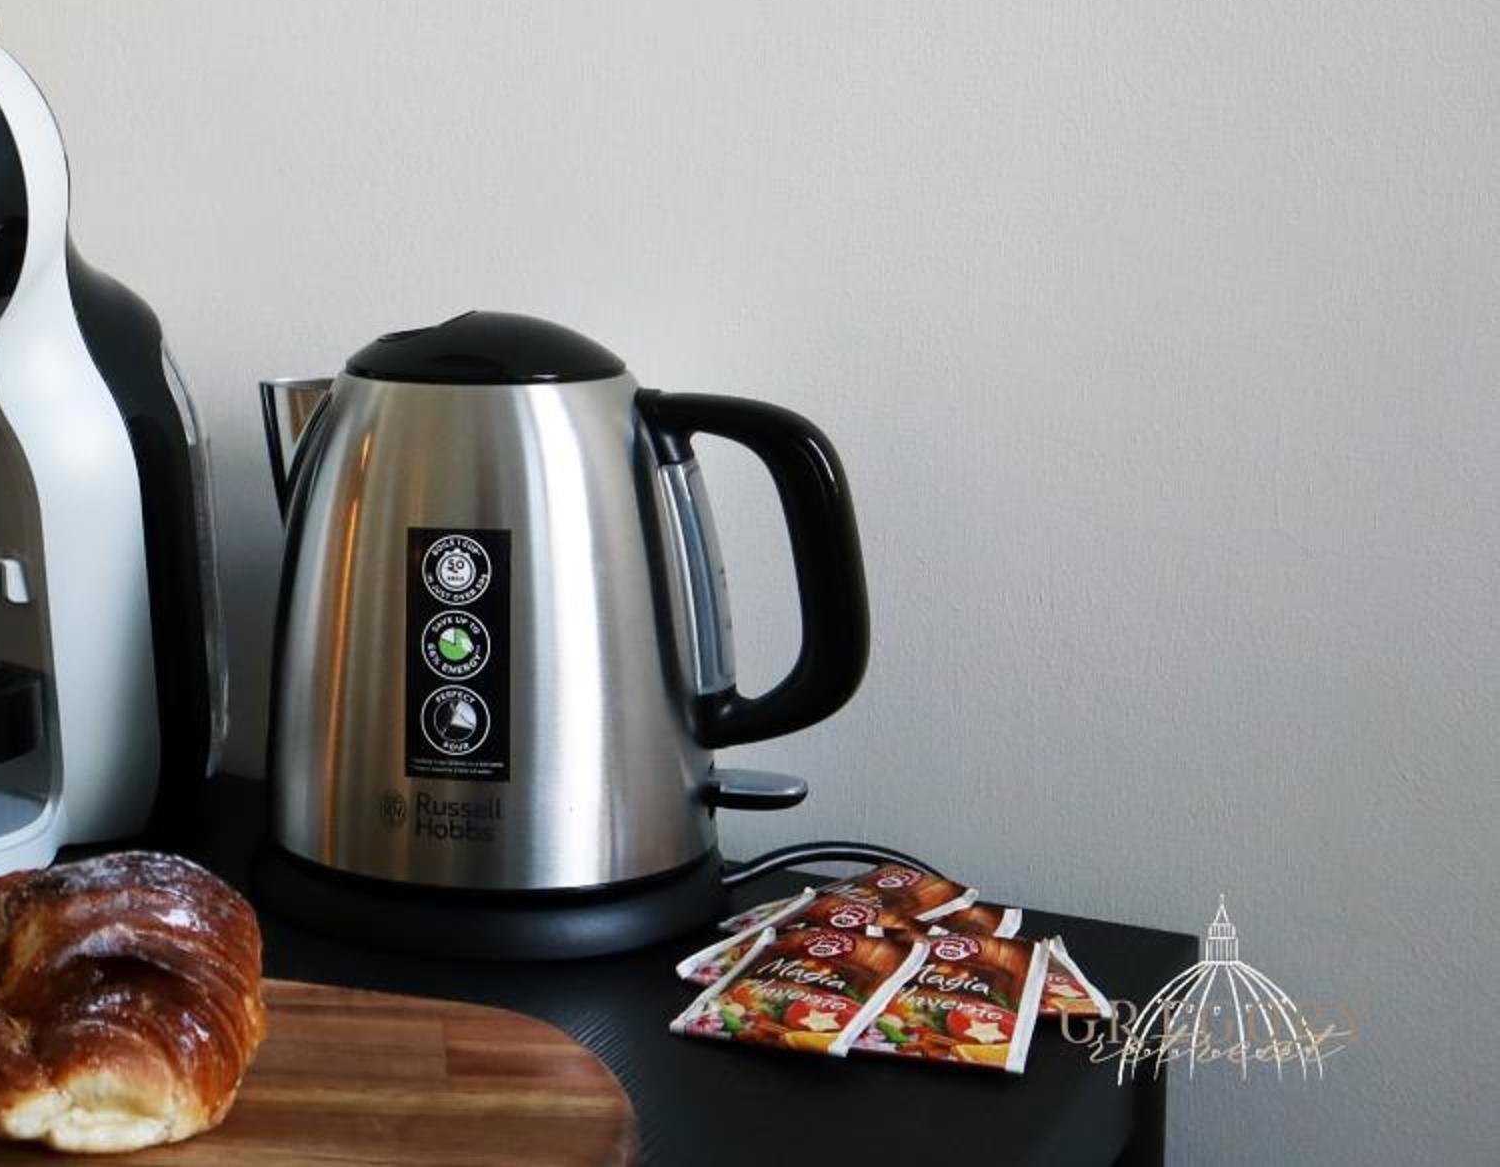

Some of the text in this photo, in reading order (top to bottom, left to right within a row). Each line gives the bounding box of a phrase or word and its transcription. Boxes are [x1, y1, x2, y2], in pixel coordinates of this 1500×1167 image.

[417, 792, 500, 819] Russell
[416, 817, 494, 842] Hobbs
[757, 958, 846, 990] Magia
